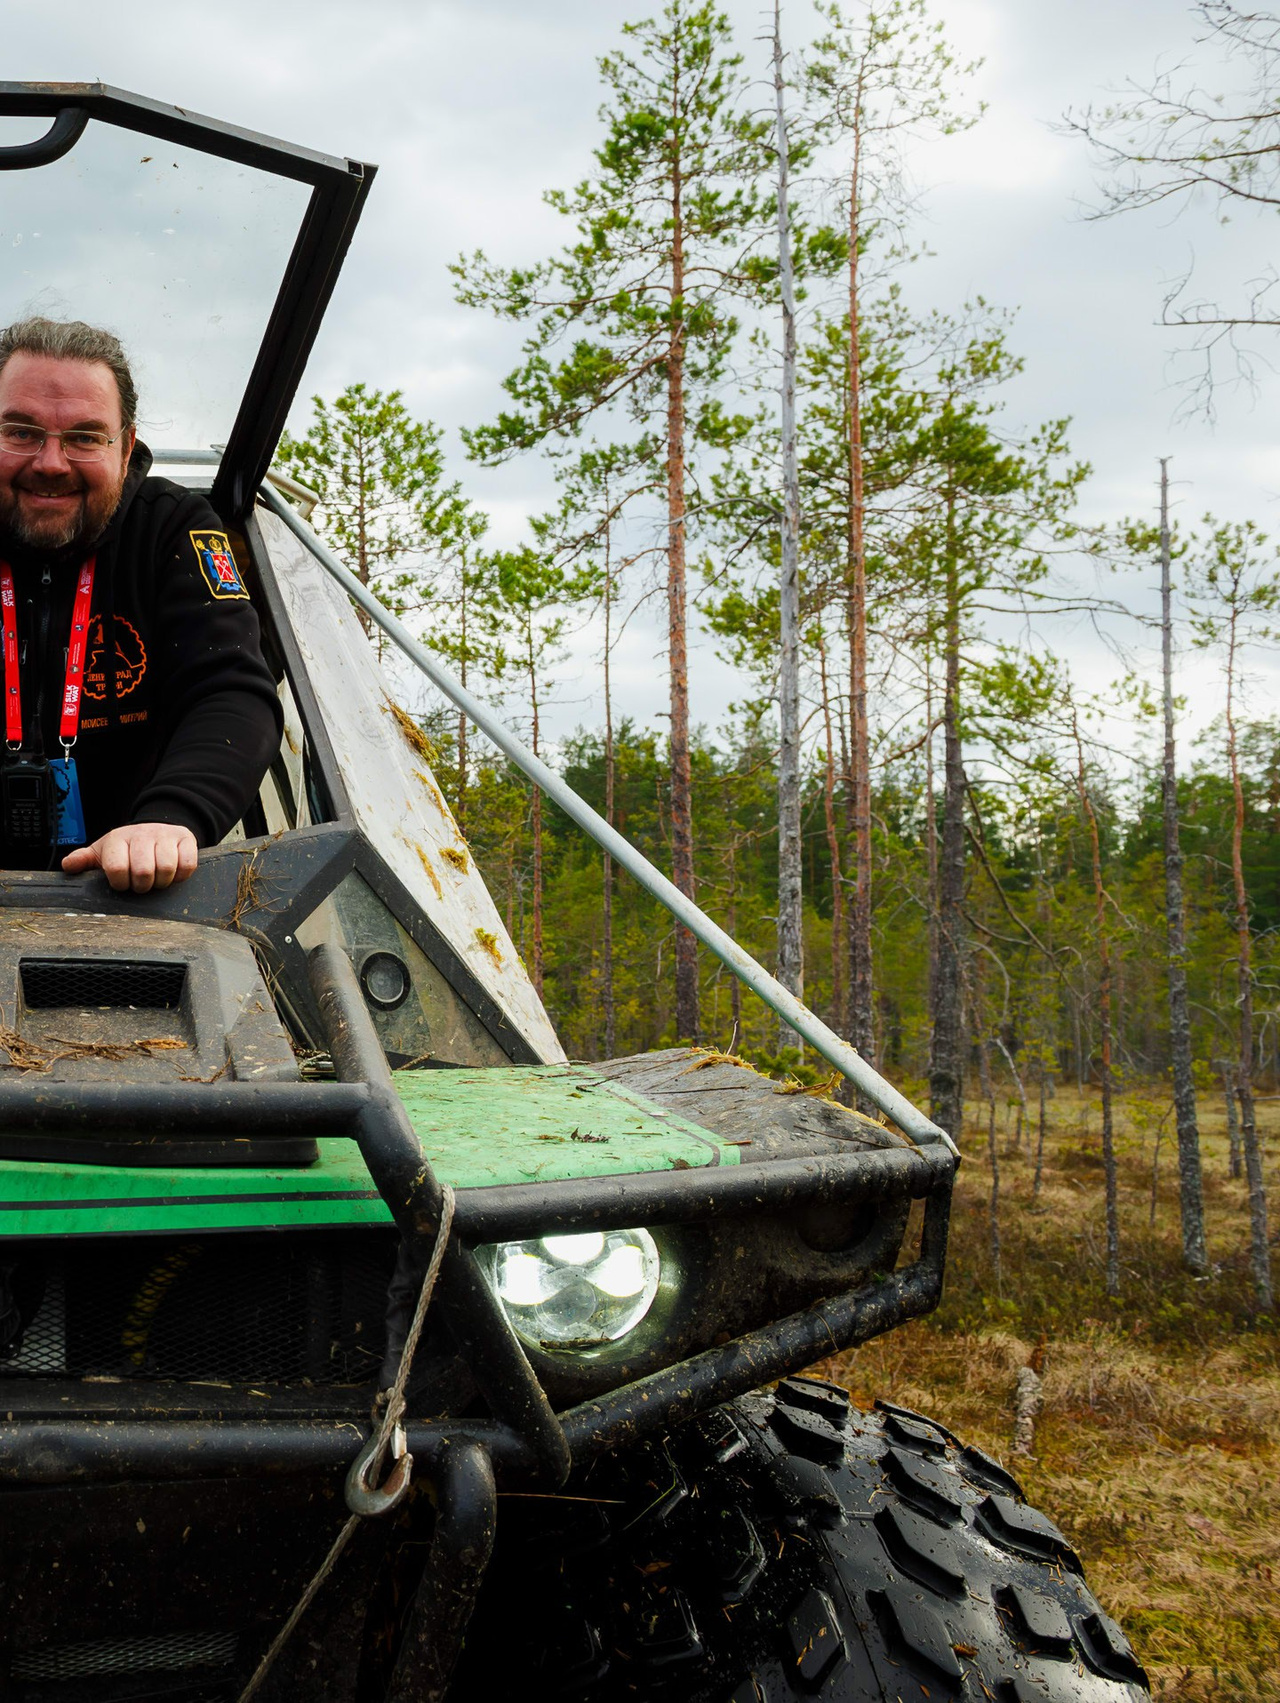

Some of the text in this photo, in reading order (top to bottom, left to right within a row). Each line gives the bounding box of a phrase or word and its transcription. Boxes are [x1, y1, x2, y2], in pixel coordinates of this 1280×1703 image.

[1, 590, 9, 606] WAY
[6, 590, 15, 606] SILK
[65, 684, 73, 703] SILK
[71, 684, 80, 703] WAY
[81, 717, 109, 730] МОИСЕЕ
